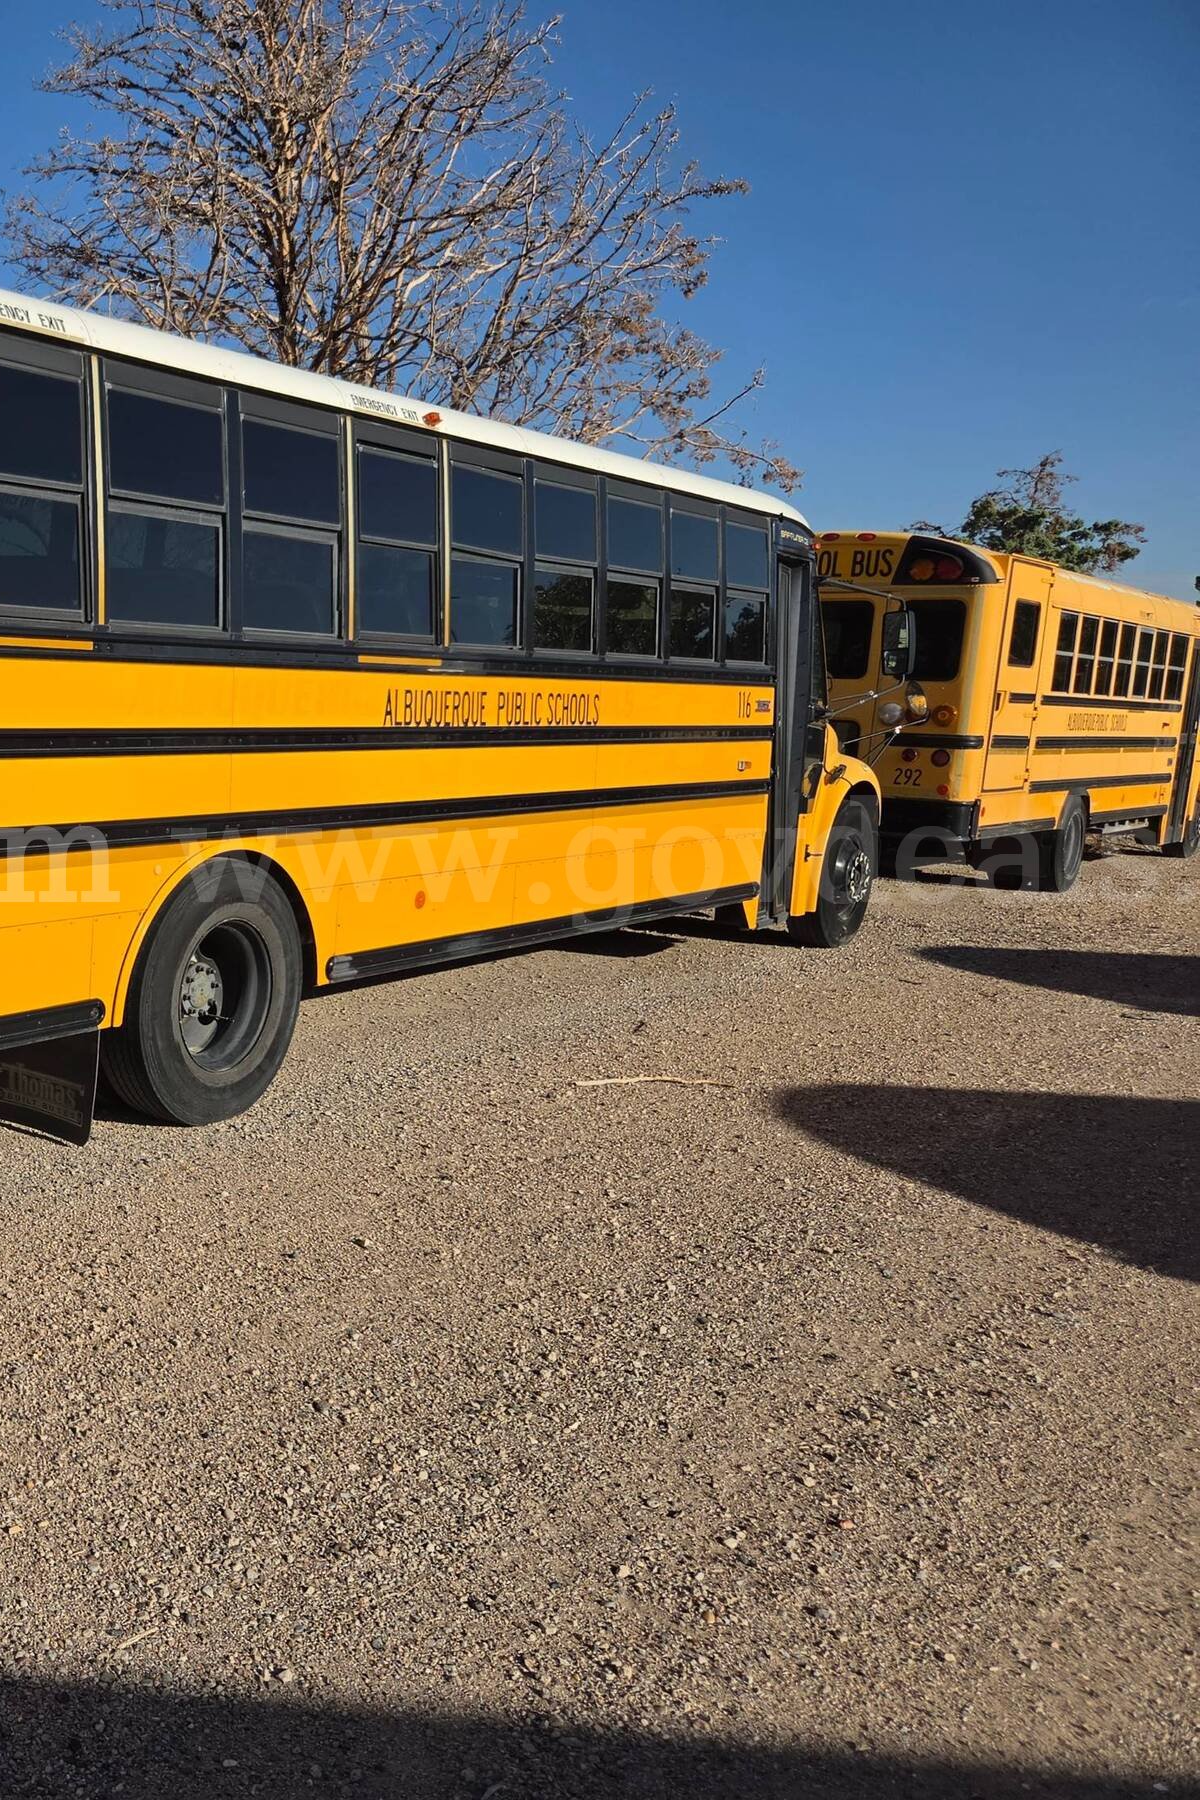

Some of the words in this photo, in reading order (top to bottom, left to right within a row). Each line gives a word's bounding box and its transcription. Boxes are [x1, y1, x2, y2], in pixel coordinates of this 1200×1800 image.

[38, 313, 66, 332] EXIT
[350, 394, 398, 416] EMERGENCY
[401, 408, 419, 422] EXIT
[851, 549, 894, 577] BUS
[384, 688, 487, 727] ALBUQUERQUE
[497, 692, 542, 726] PUBLIC
[547, 693, 599, 726] SCHOOLS
[738, 691, 751, 719] 116
[893, 768, 922, 786] 292
